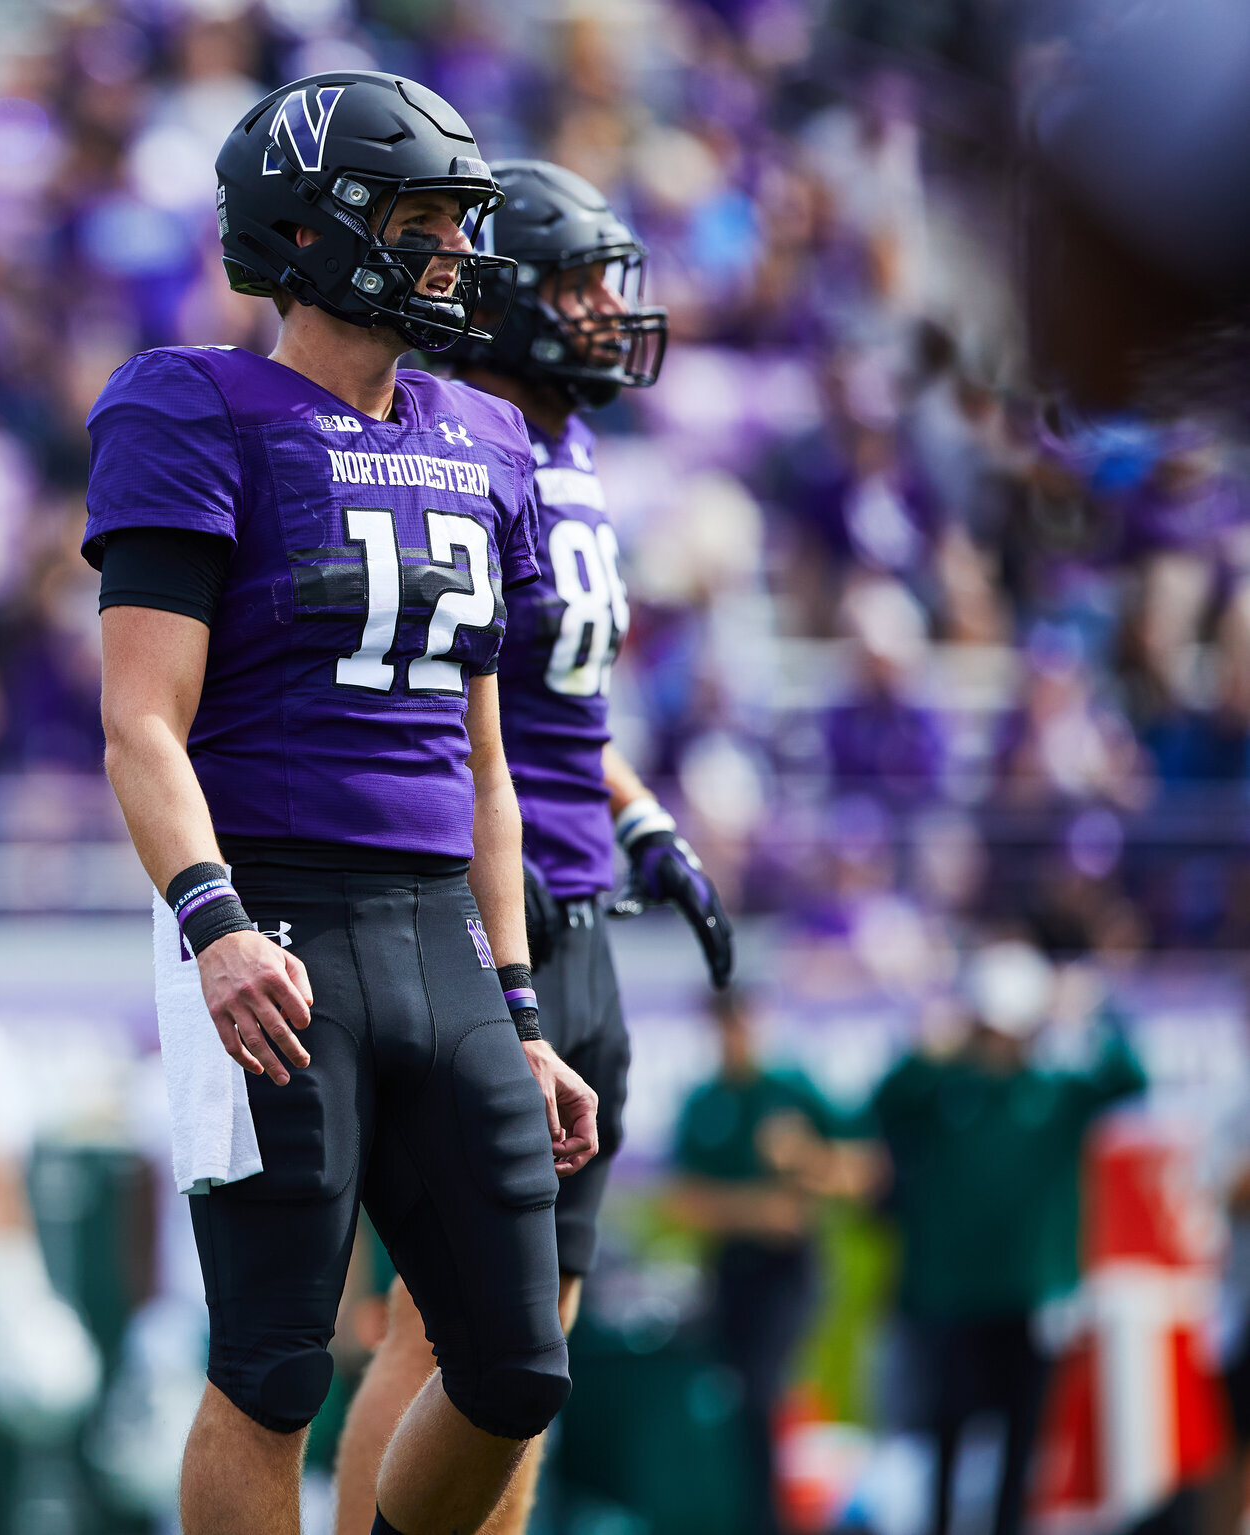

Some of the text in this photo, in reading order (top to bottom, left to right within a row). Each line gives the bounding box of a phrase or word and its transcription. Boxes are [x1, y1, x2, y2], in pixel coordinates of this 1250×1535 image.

[262, 88, 345, 175] N
[327, 449, 489, 498] NORTHWESTERN
[333, 507, 496, 696] 12
